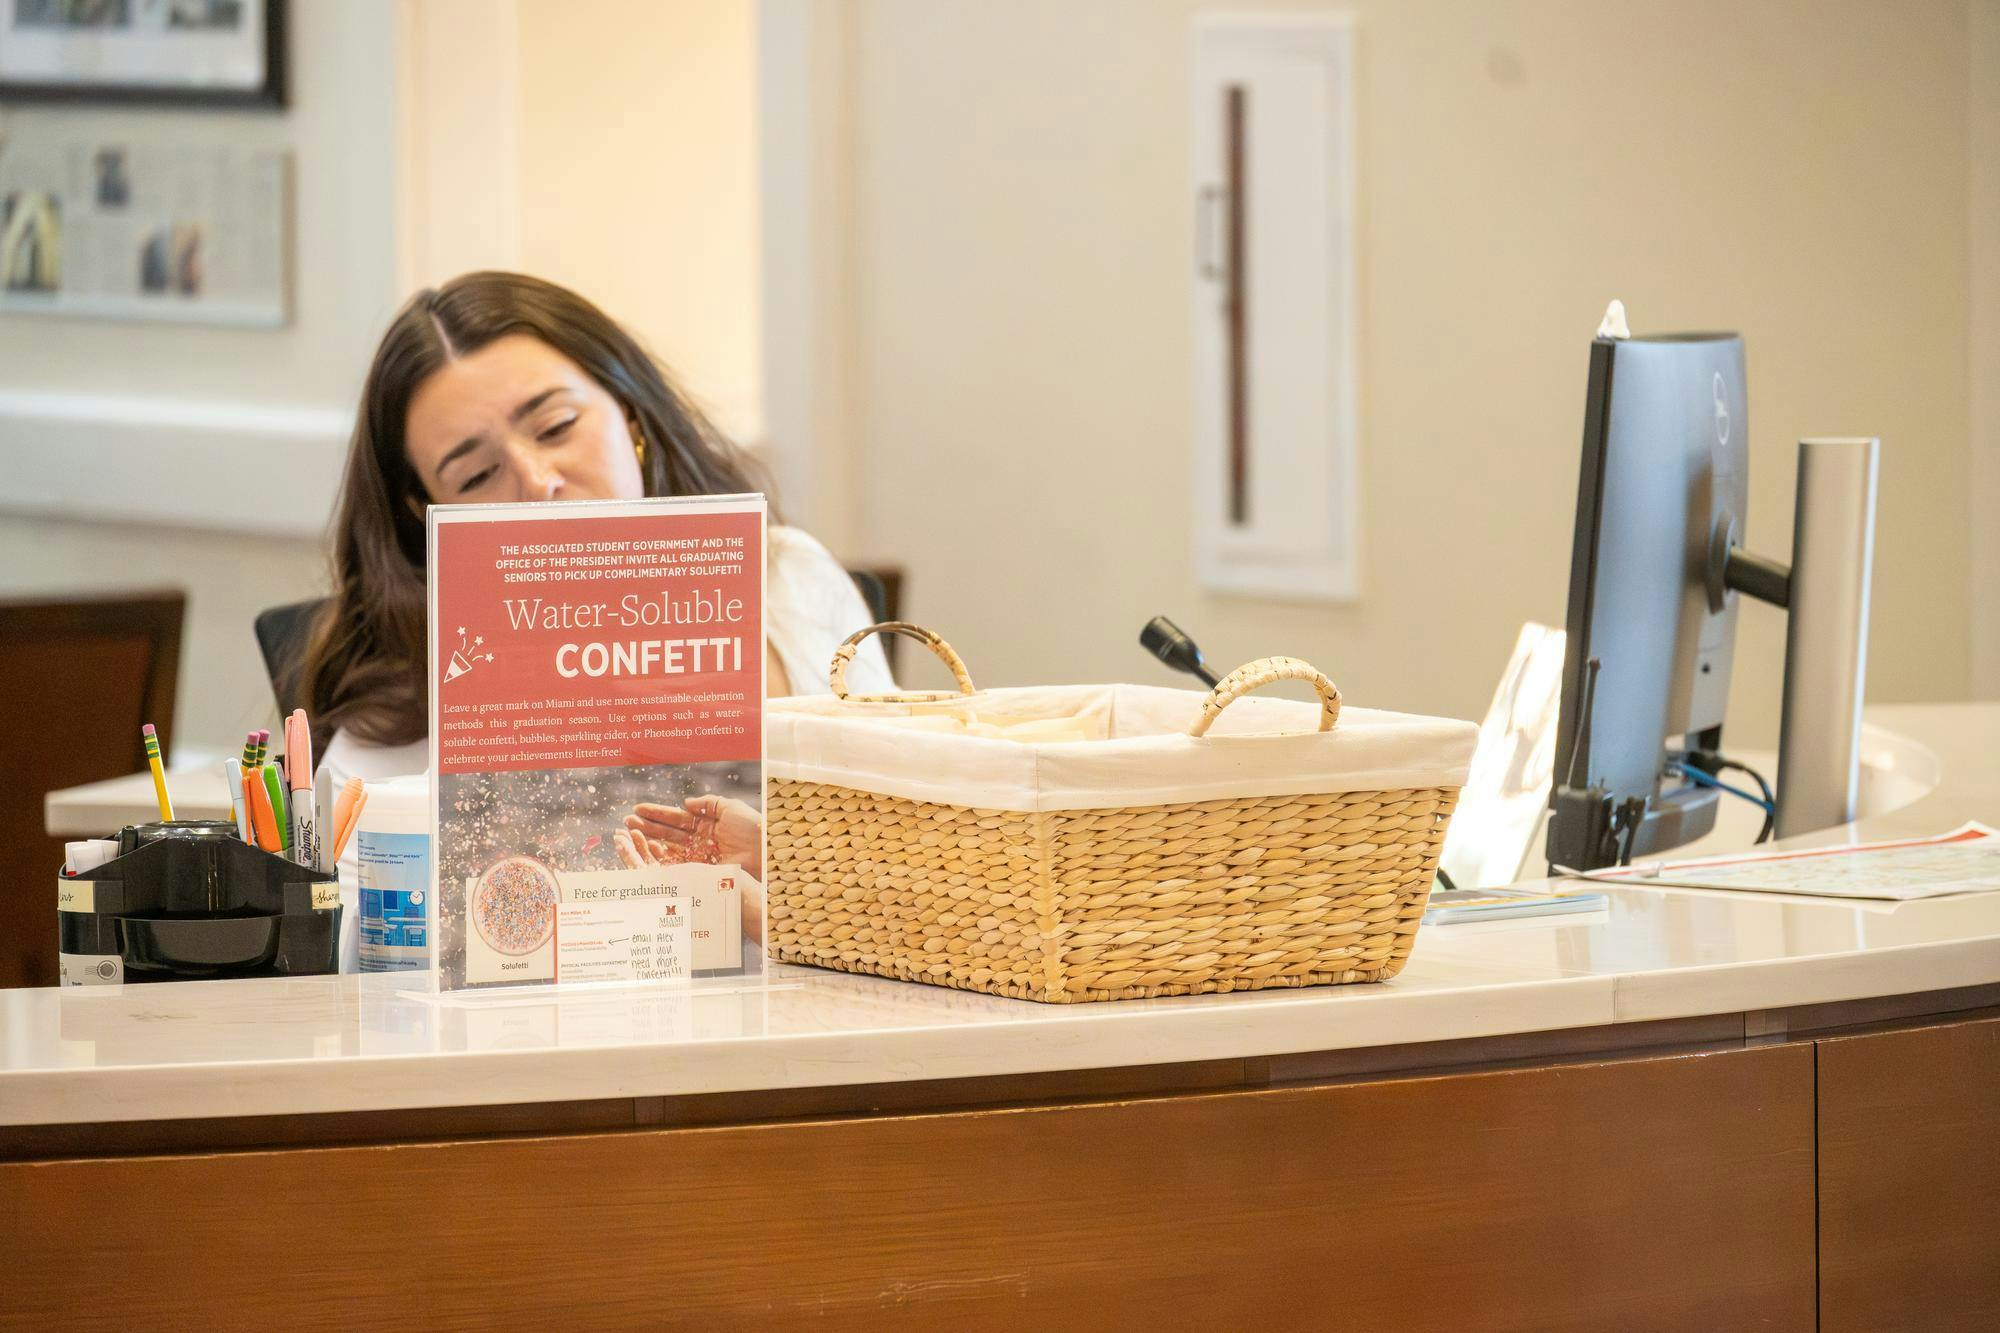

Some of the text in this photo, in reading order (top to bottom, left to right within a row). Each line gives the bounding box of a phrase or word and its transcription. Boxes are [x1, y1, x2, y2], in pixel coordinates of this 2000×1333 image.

[500, 537, 744, 555] THE ASSOCIATED STUDENT GOVERNMENT AND THE
[496, 551, 744, 569] OFFICE OF THE PRESIDENT INVITE ALL GRADUATING
[504, 565, 742, 583] SENIORS TO PICK UP COMPLIMENTARY SOLUFETTI
[503, 588, 744, 630] Water-Soluble
[556, 636, 742, 678] CONFETTI
[444, 704, 470, 713] Leave
[480, 702, 502, 714] great
[506, 700, 529, 710] mark
[532, 701, 543, 709] on
[546, 698, 574, 708] Miami
[577, 697, 594, 707] and
[614, 697, 639, 705] more
[640, 693, 691, 705] sustainable
[694, 691, 744, 702] celebration
[444, 709, 744, 730] methods this graduation season. Use options such as water-
[444, 725, 744, 747] soluble confetti, bubbles, sparkling cider, or Photoshop Confetti to
[444, 747, 622, 765] celebrate your achievements litter-free!
[301, 816, 313, 861] Sharpie
[574, 884, 678, 900] Free for graduating
[632, 933, 674, 943] email Alex
[630, 945, 672, 956] when you
[501, 962, 529, 970] Solufetti
[631, 956, 678, 969] need more
